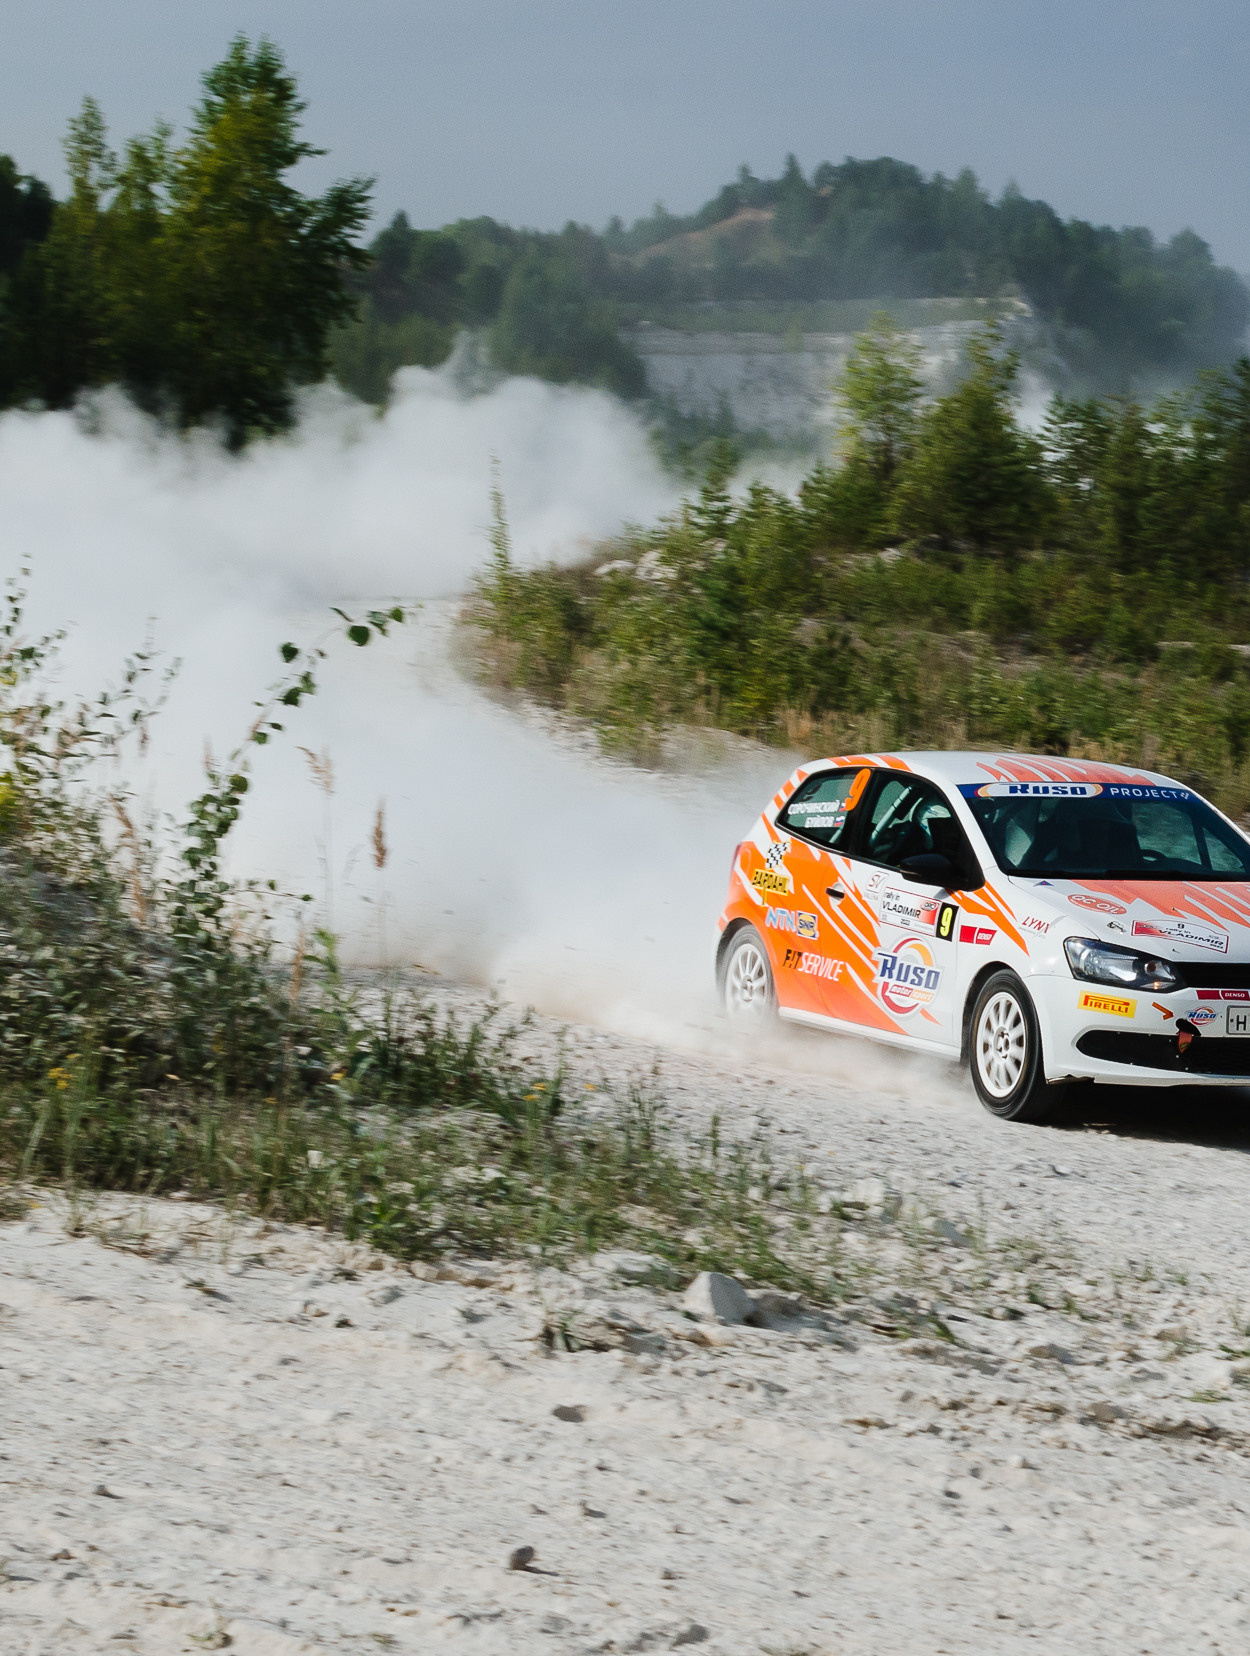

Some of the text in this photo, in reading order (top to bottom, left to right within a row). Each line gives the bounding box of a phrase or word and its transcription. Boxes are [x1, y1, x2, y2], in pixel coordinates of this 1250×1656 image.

[845, 768, 871, 811] 9
[1111, 788, 1178, 799] PROJECT
[882, 900, 922, 919] VLADIMIR
[1096, 903, 1119, 914] OIL
[765, 909, 796, 931] NTN
[940, 907, 953, 937] 9
[1159, 929, 1224, 946] VLADIMIR
[798, 952, 844, 982] SERVICE
[1083, 995, 1130, 1014] PIRELLI
